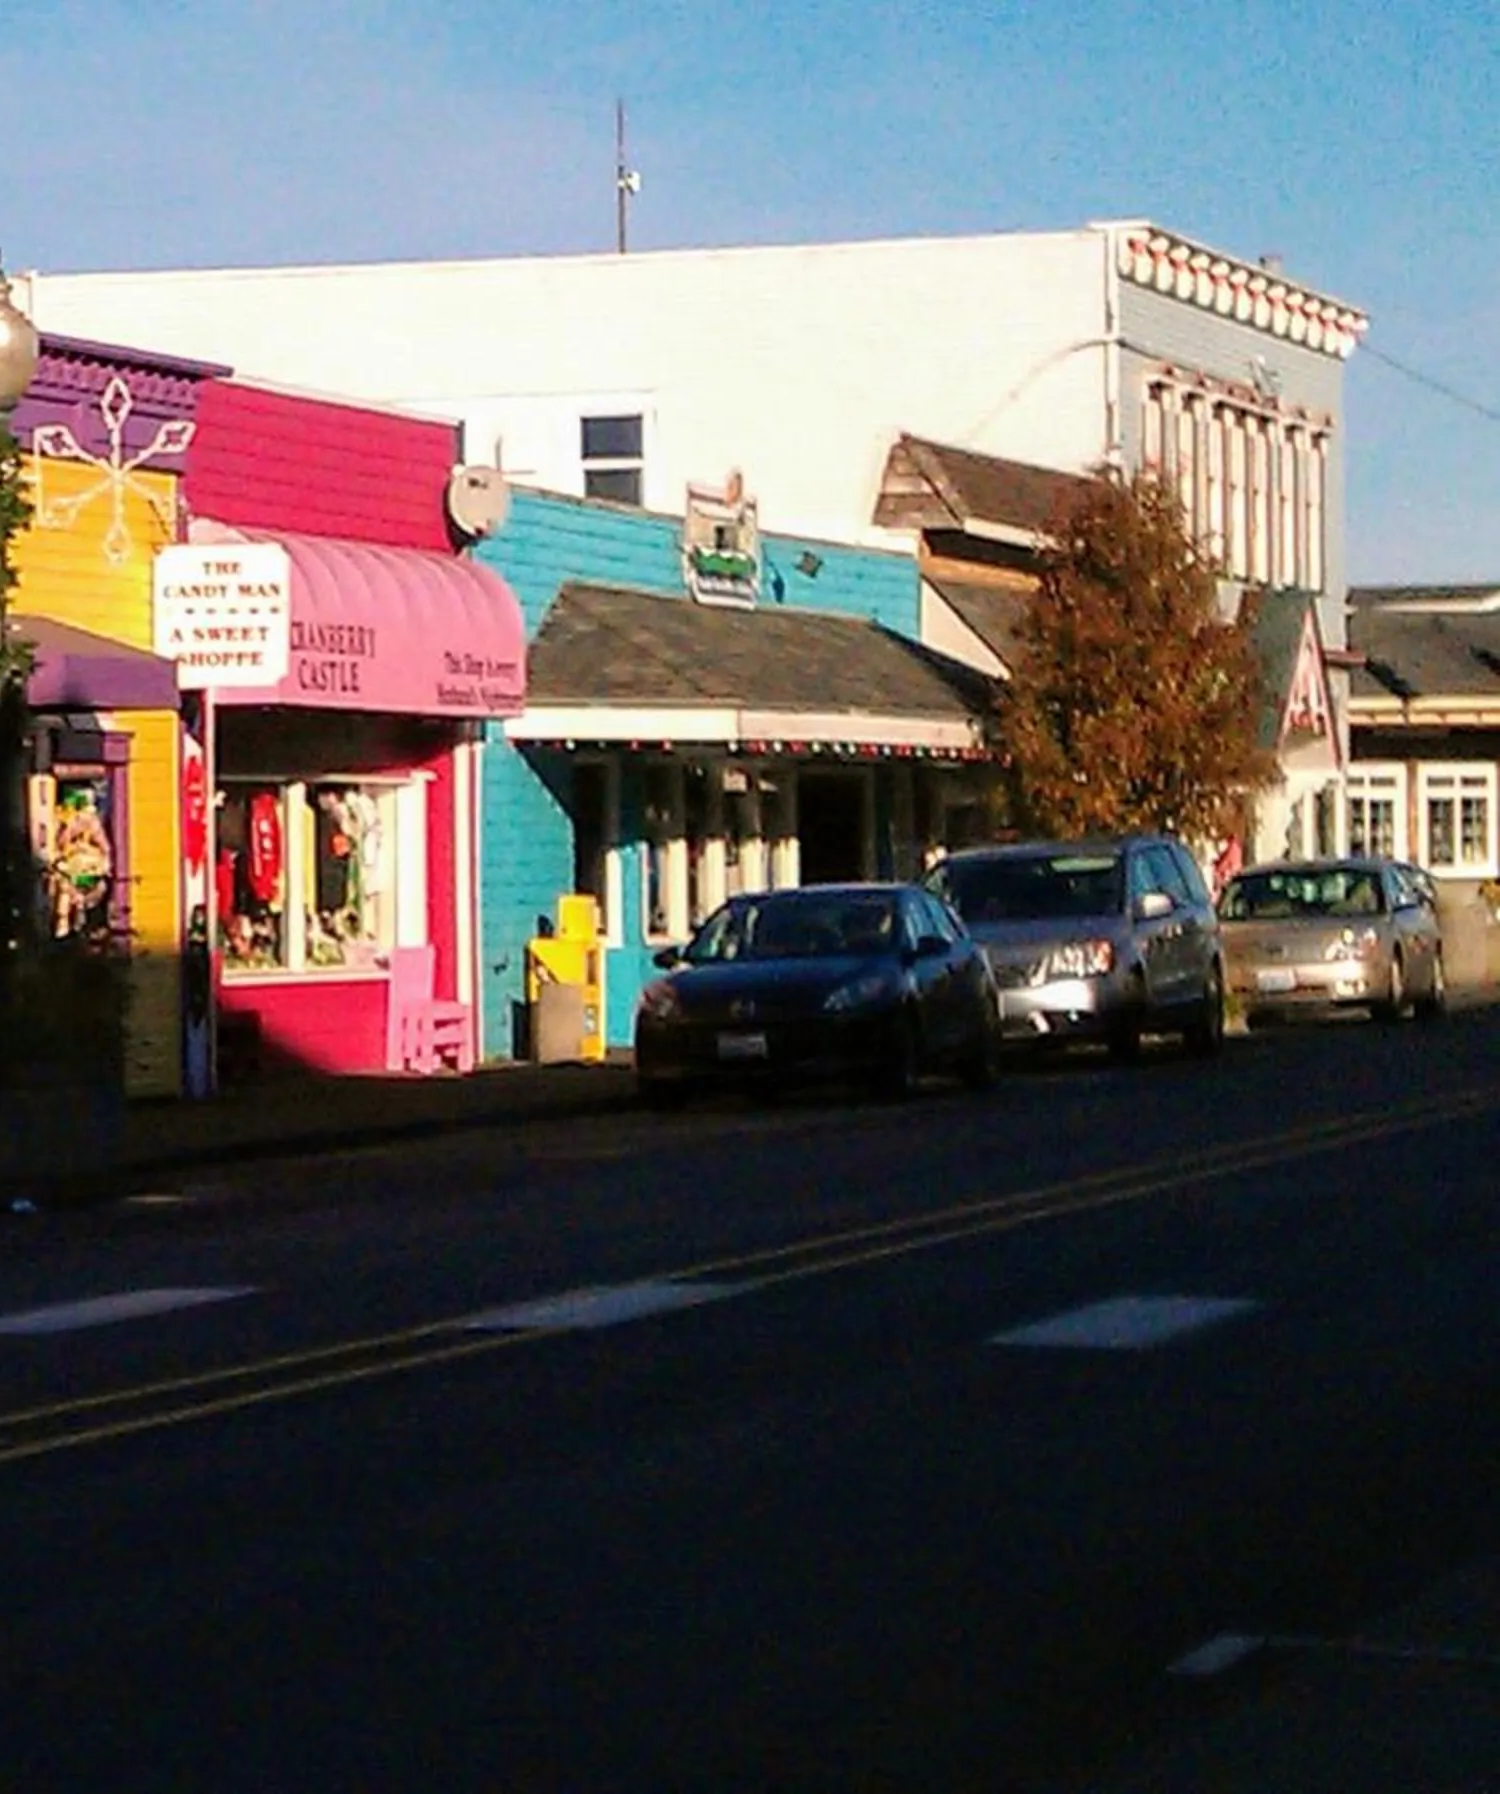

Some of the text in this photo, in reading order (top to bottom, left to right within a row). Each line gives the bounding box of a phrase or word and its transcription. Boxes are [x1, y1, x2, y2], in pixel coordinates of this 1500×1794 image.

[202, 561, 241, 575] THE
[162, 582, 281, 599] CANDY MAN
[169, 625, 269, 643] A SWEET
[290, 620, 375, 659] CRANBERRY
[176, 650, 263, 667] SHOPPE
[297, 657, 360, 693] CASTLE
